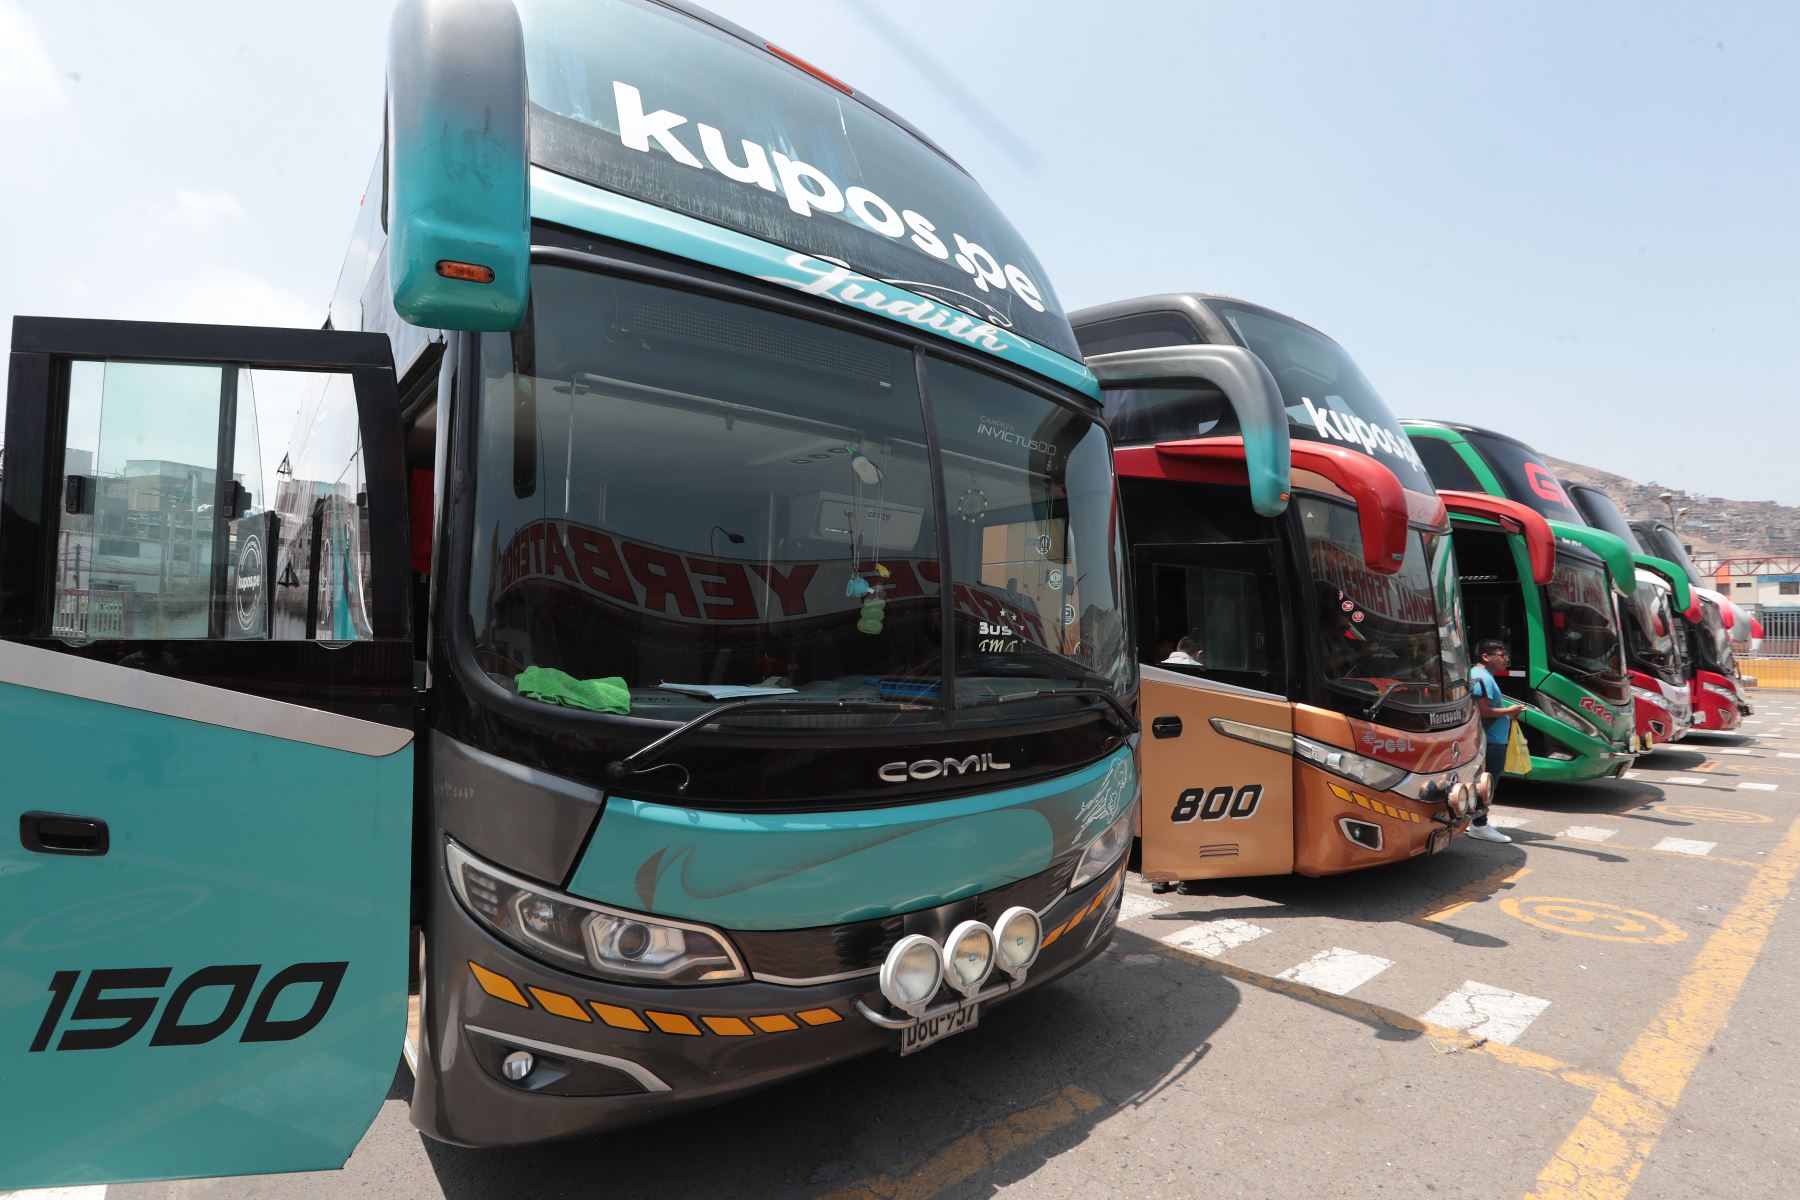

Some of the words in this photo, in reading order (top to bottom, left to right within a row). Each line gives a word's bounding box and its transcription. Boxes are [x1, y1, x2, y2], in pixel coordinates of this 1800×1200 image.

[612, 80, 1046, 313] kupos.pe
[878, 752, 1011, 783] COMIL
[1170, 784, 1265, 824] 800
[28, 961, 350, 1052] 1500
